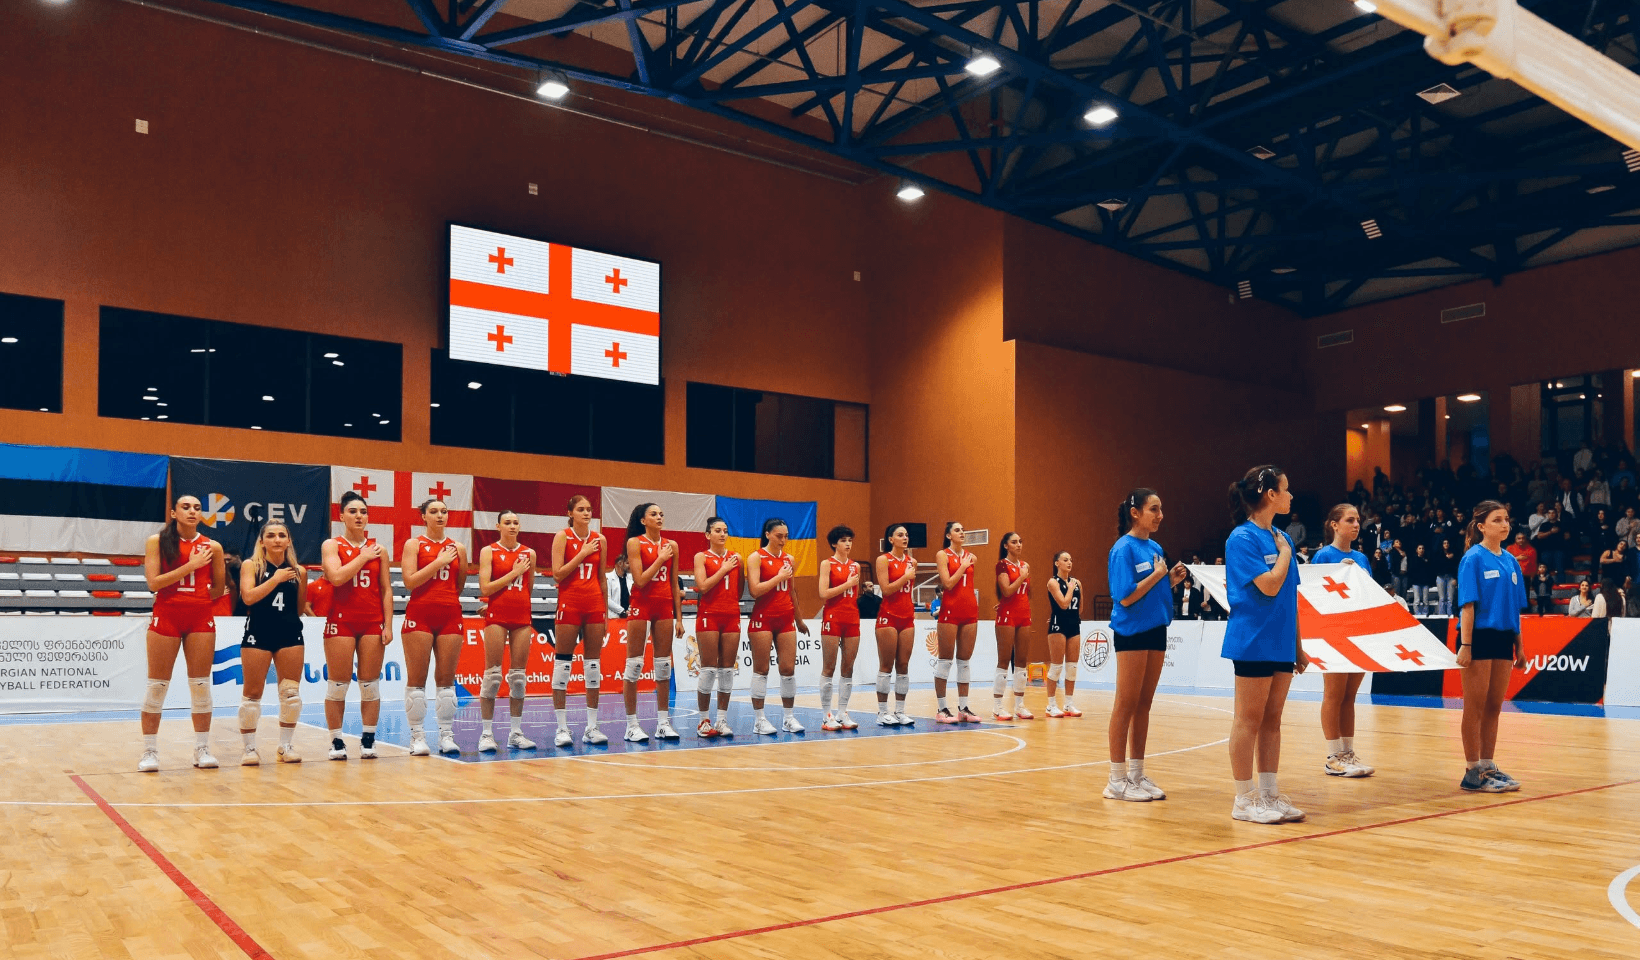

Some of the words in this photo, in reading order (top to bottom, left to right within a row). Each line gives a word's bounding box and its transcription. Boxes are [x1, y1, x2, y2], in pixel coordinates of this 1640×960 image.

[243, 502, 307, 524] CEV
[577, 563, 593, 580] 17
[352, 569, 371, 588] 15
[272, 592, 285, 611] 4
[326, 623, 338, 635] 15
[247, 635, 257, 645] 4
[797, 640, 811, 651] OF
[541, 652, 584, 662] Wen
[41, 667, 98, 676] NATIONAL
[40, 680, 110, 689] FEDERATION
[455, 672, 484, 685] ürki
